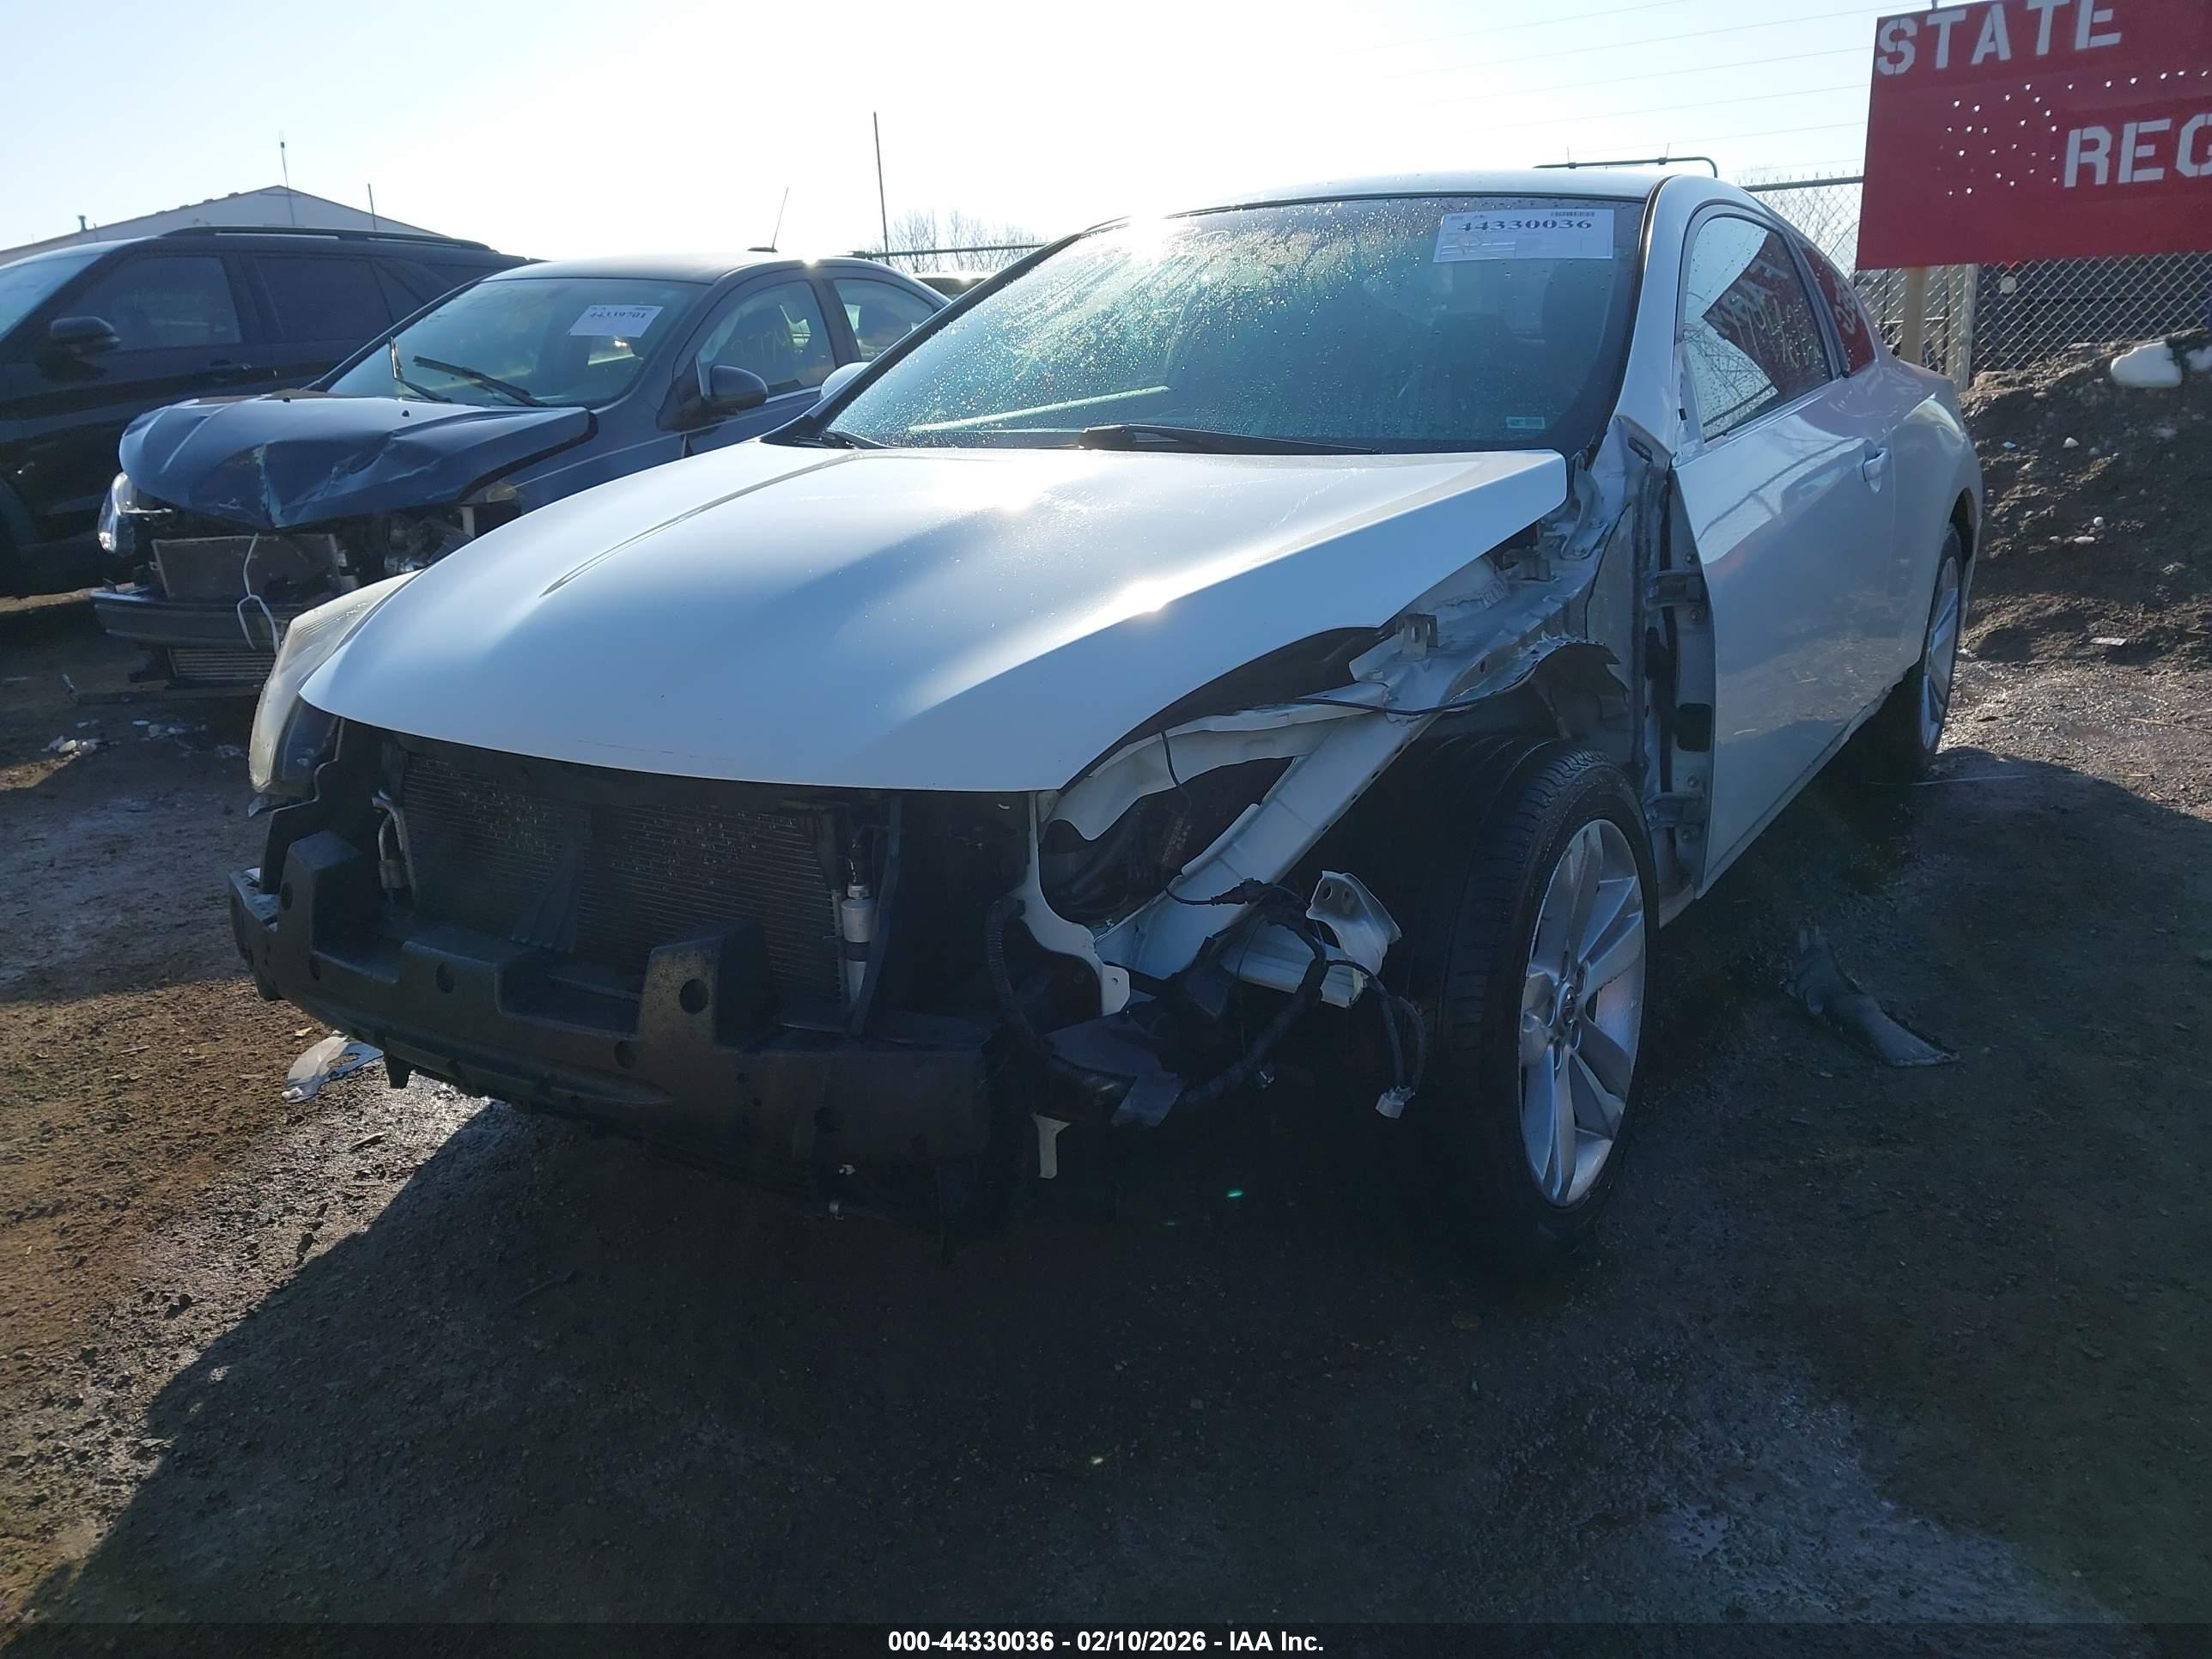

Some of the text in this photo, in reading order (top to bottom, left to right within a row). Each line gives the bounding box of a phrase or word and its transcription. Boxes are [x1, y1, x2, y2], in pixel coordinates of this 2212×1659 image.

[1875, 0, 2122, 76] STATE
[2063, 112, 2212, 187] REG
[1457, 219, 1592, 232] 44330036
